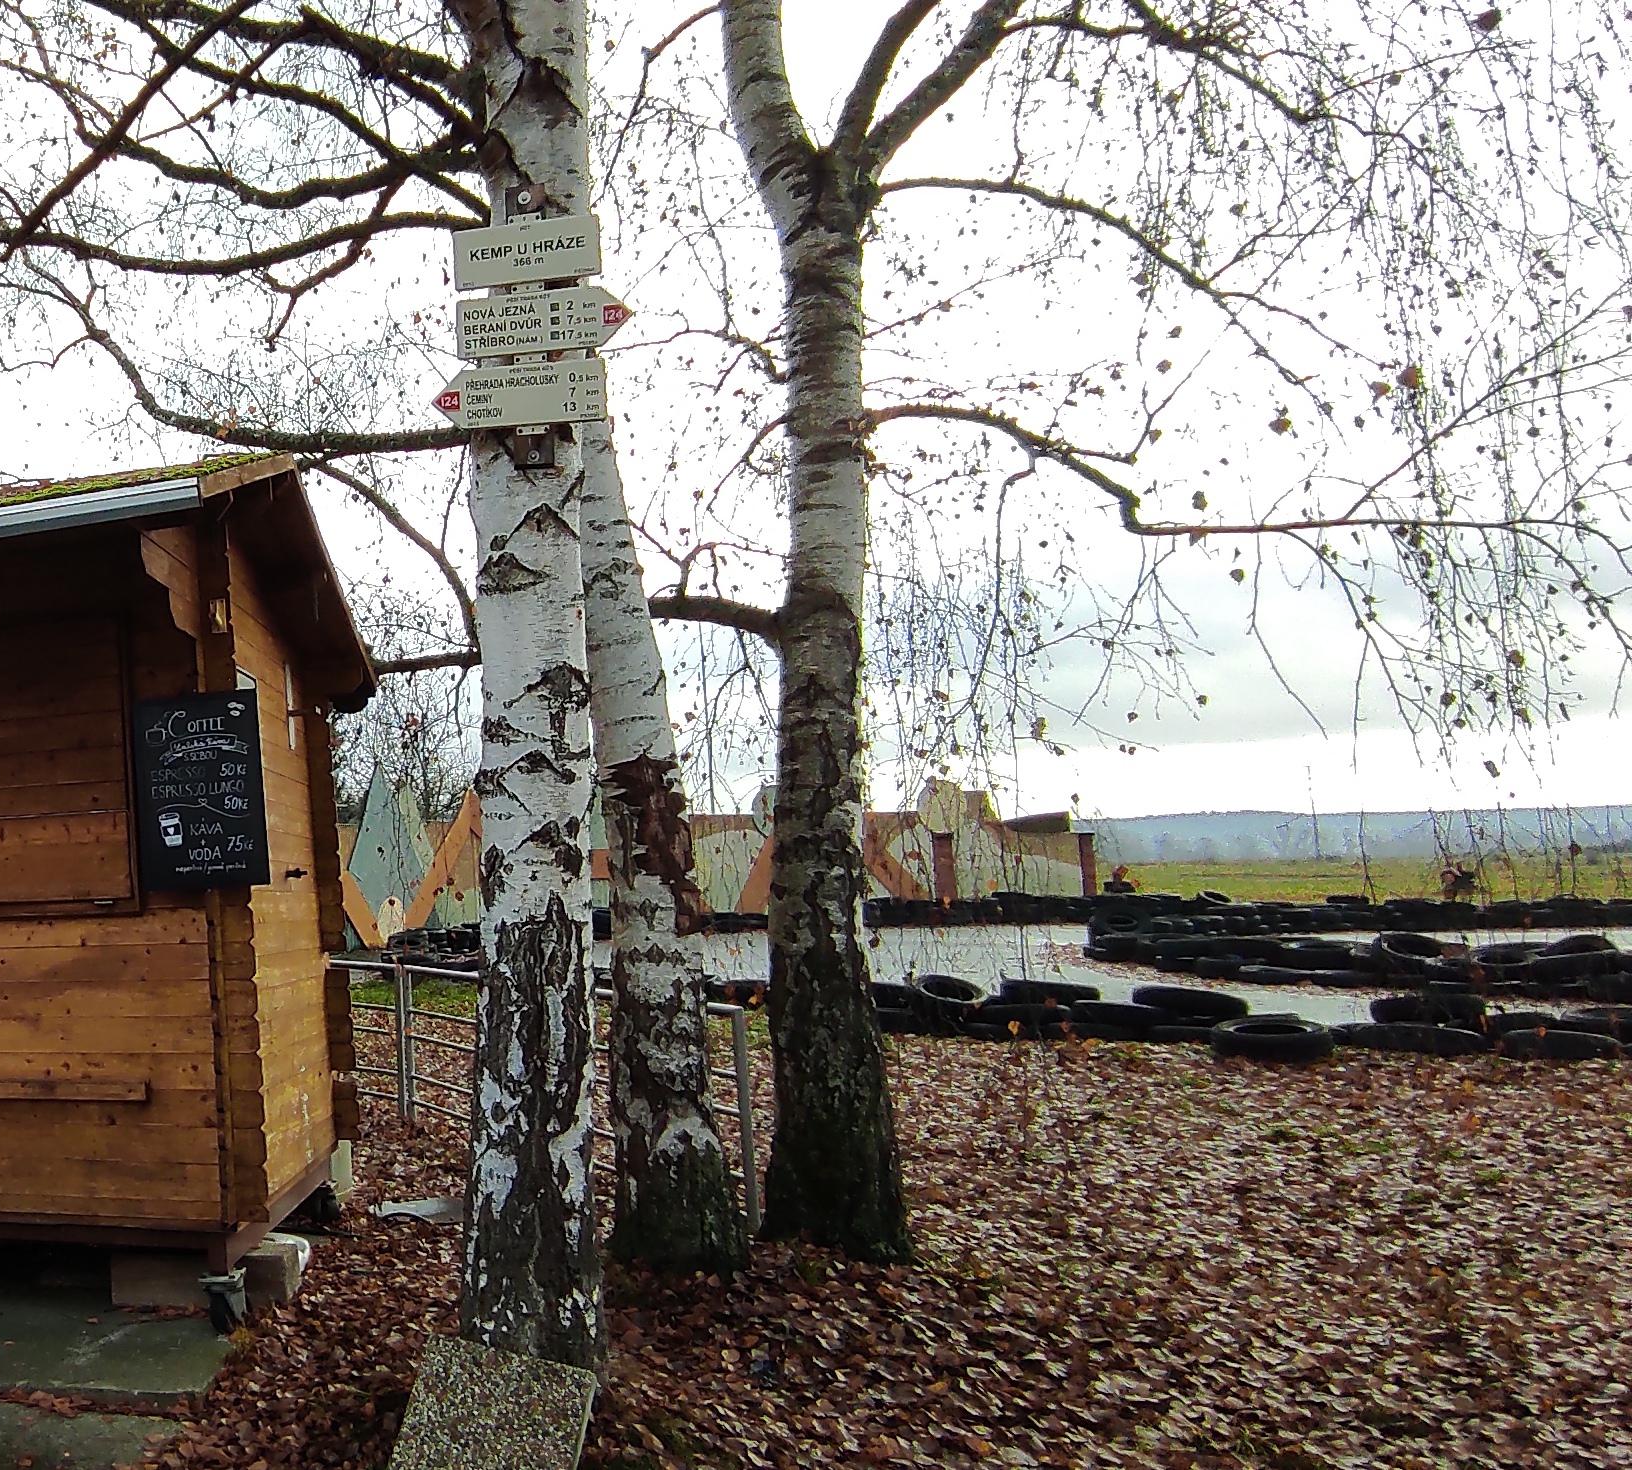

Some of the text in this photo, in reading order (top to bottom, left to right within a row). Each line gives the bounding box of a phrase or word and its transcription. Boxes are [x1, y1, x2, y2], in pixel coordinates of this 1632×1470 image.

[470, 235, 585, 261] KEMP U HRÁZE
[513, 257, 531, 267] 366
[463, 306, 495, 321] NOVÁ
[498, 304, 536, 318] JEZNÁ
[566, 301, 574, 311] 2
[464, 321, 507, 335] BERANÍ
[583, 316, 597, 324] km
[464, 335, 515, 350] STŘÍBRO
[465, 378, 504, 391] PŘEHRADA
[505, 374, 559, 388] HRACHOLUSKY
[440, 395, 459, 407] 124
[466, 387, 599, 406] ČEMINY 7 km
[466, 402, 599, 420] CHOTÍKOV 13 km
[168, 710, 225, 737] COFFEE
[209, 780, 244, 795] LUNGO
[188, 846, 222, 861] VODA
